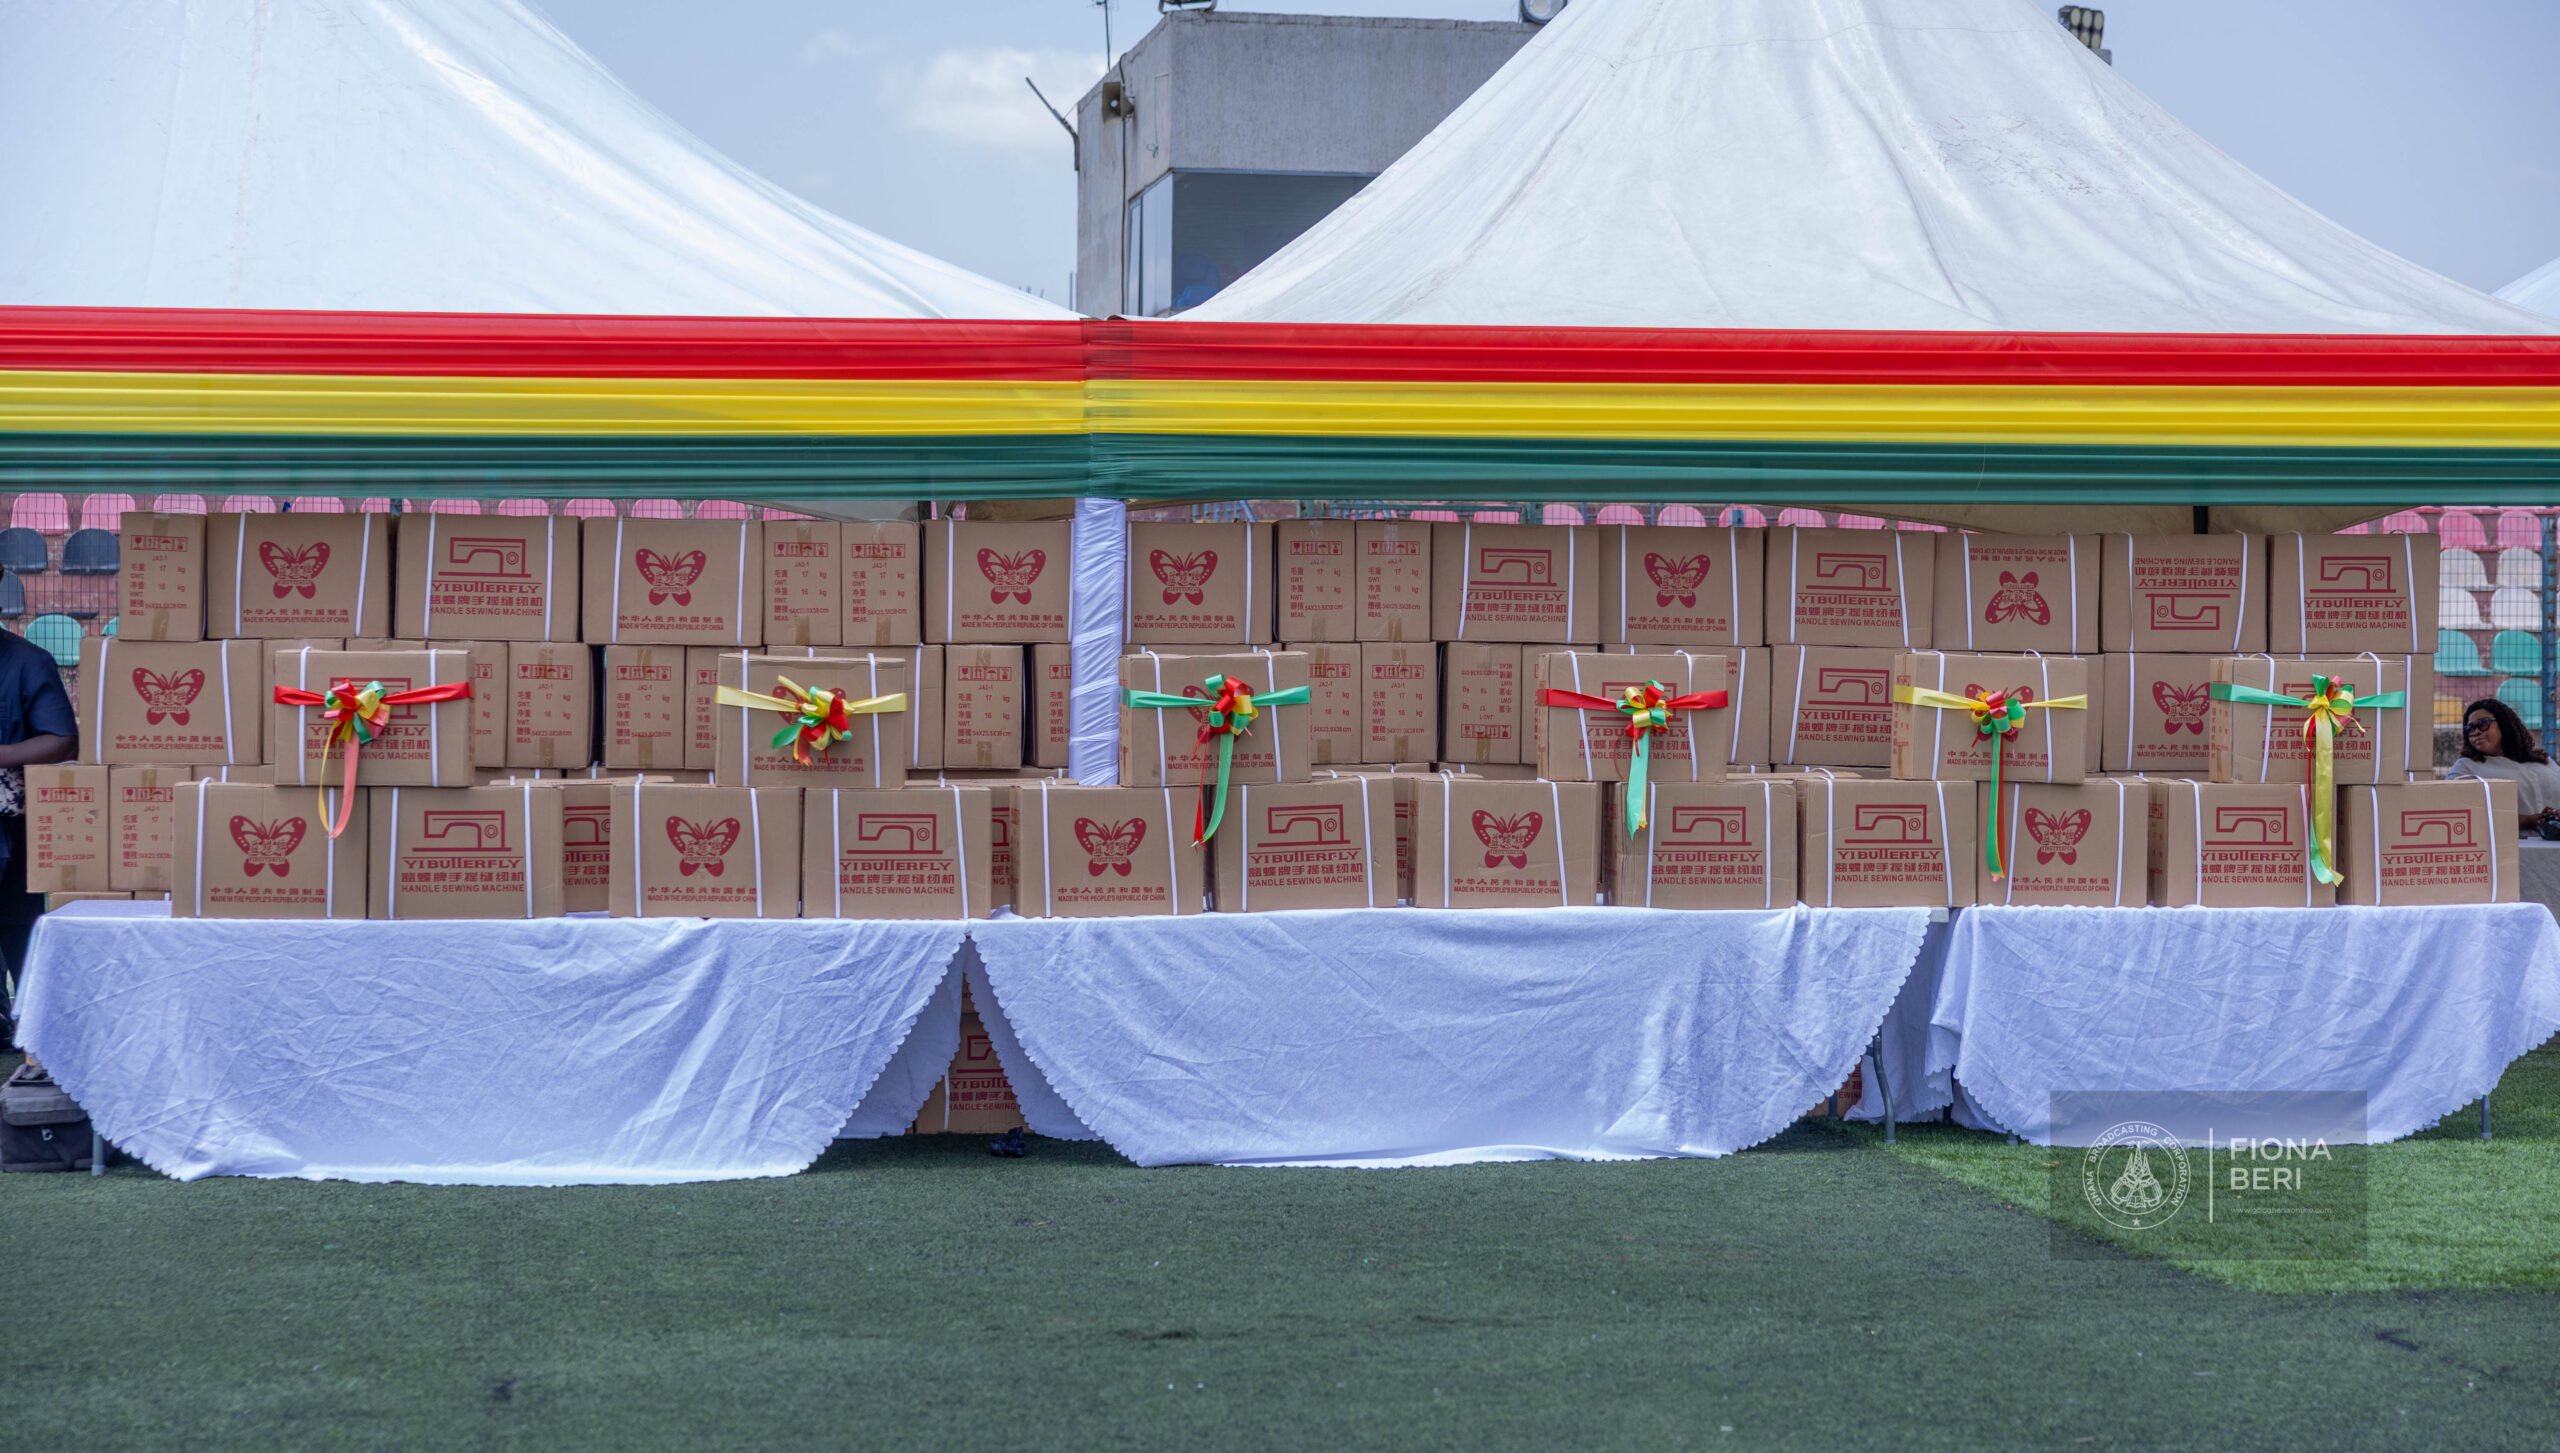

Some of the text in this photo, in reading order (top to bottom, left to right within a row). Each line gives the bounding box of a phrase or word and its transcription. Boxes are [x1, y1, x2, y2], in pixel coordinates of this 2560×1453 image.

[466, 607, 501, 615] SEWING
[503, 608, 542, 616] MACHINE
[1287, 877, 1321, 885] SEWING
[1324, 875, 1363, 883] MACHINE
[2382, 878, 2414, 886] HANDLE
[2451, 876, 2488, 884] MACHINE
[482, 884, 524, 892] MACHINE
